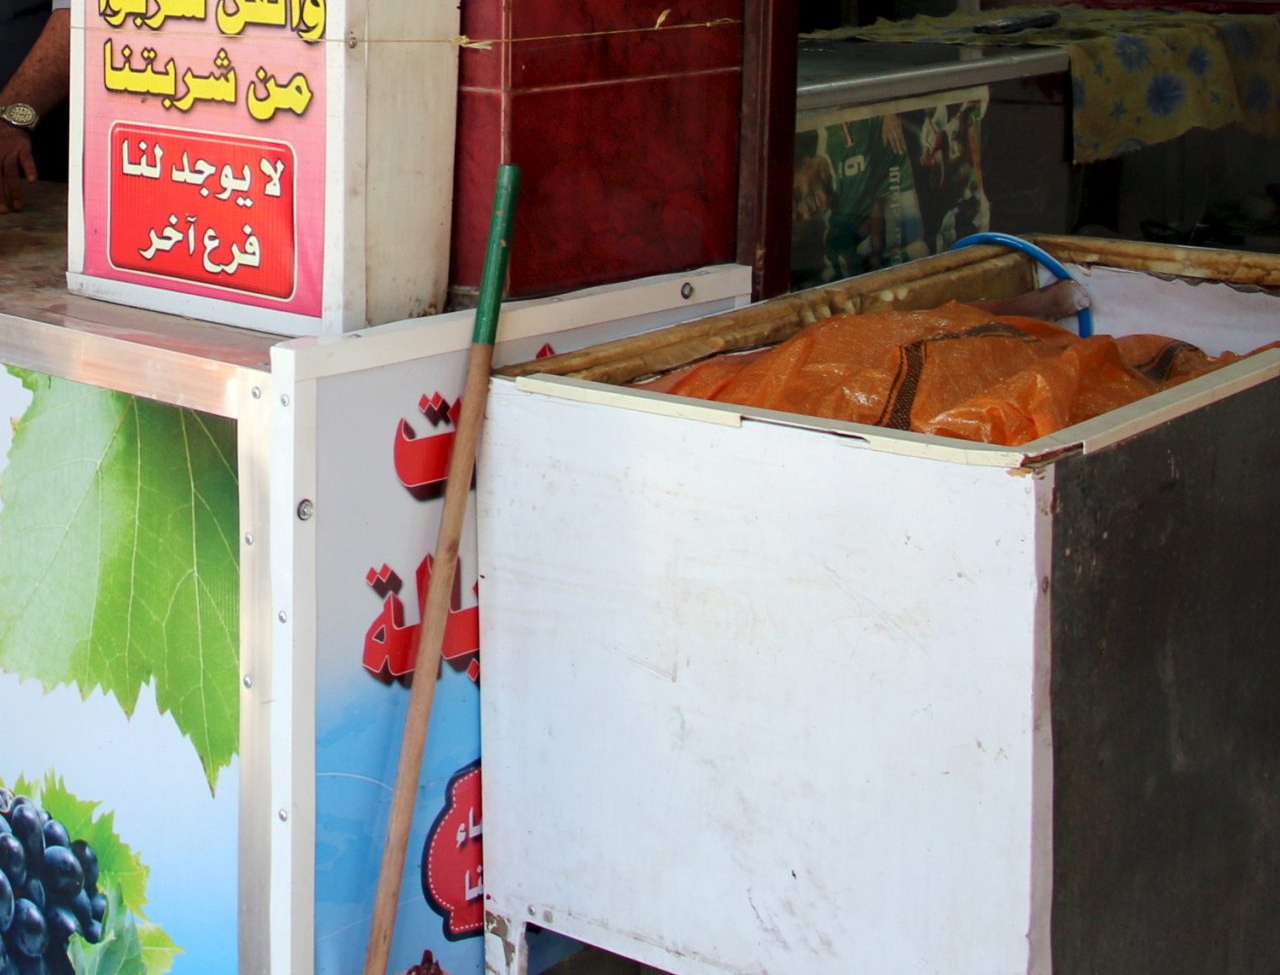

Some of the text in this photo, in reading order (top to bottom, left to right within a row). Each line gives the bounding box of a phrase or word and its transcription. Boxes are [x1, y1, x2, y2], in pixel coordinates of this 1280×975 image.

[102, 39, 315, 122] من شربتنا
[120, 137, 286, 208] لا يوجد لنا
[138, 214, 262, 275] فرع آخر
